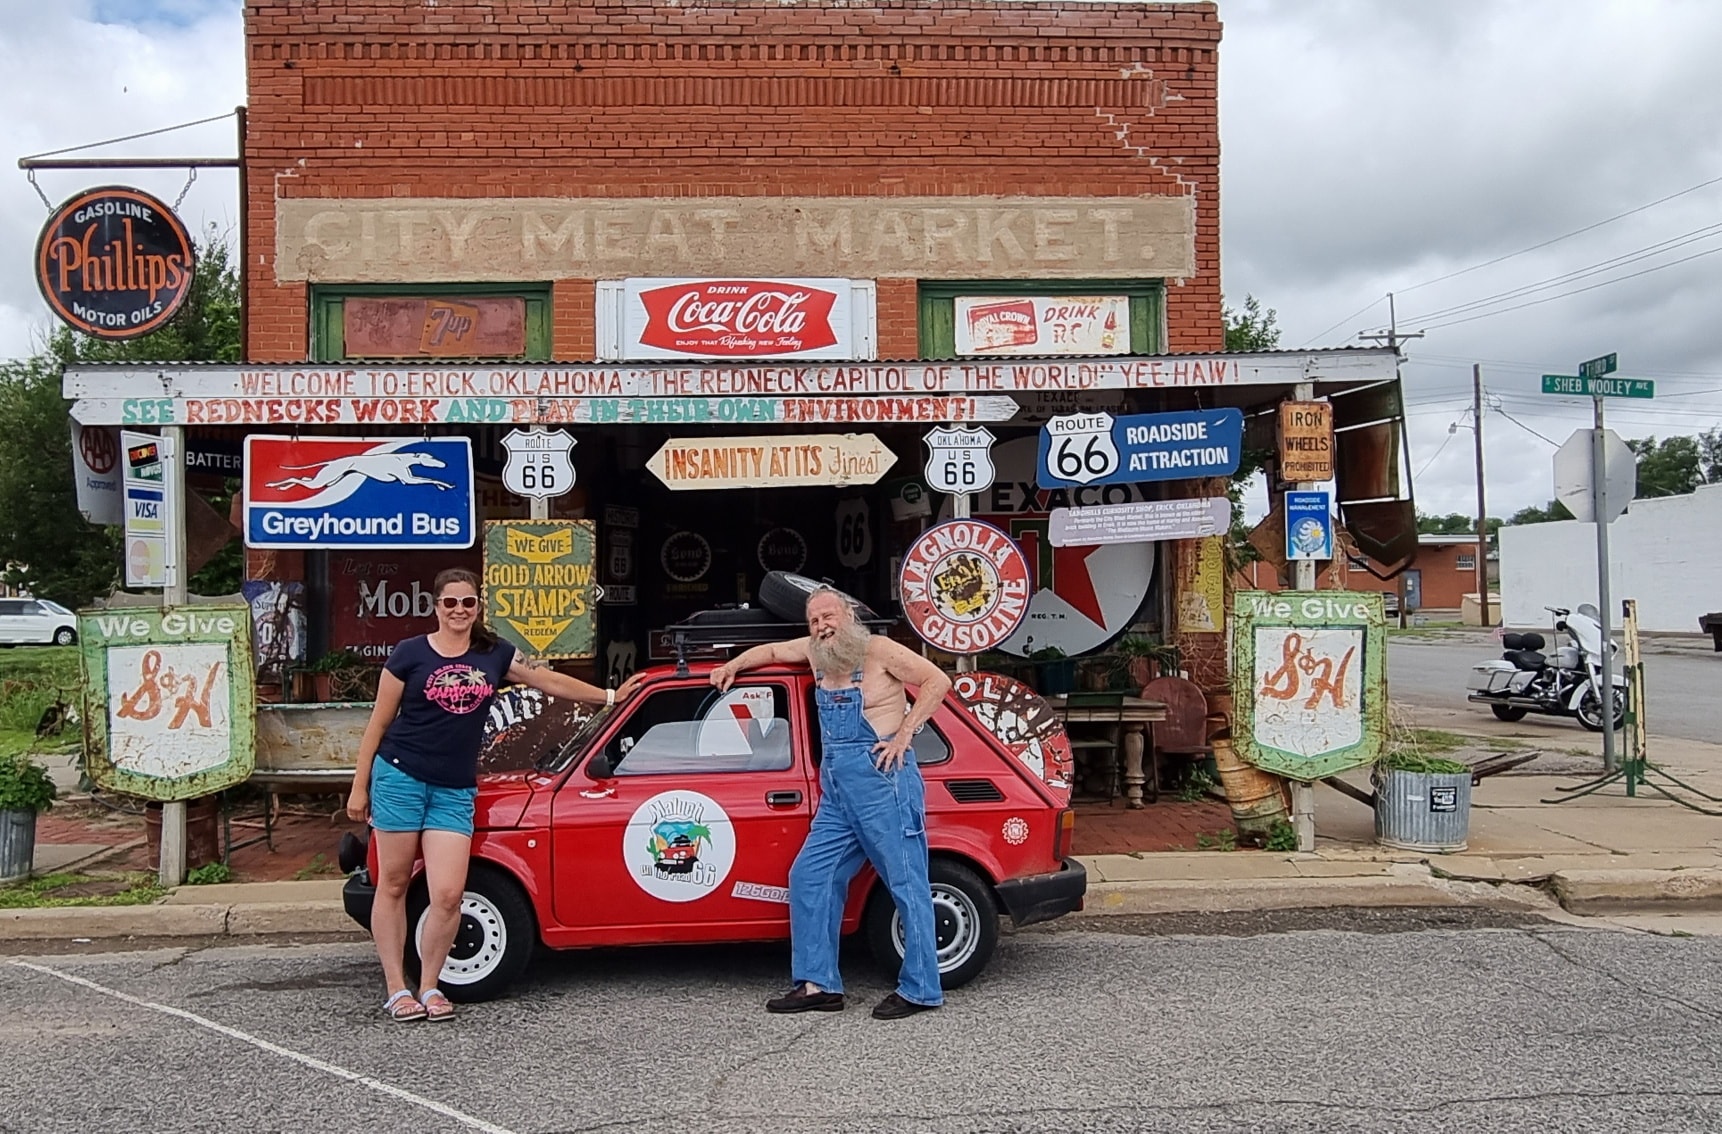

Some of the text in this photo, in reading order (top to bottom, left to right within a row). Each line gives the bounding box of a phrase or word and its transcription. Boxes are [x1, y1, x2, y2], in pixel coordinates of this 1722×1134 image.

[74, 203, 152, 224] GASOLINE
[304, 207, 1156, 262] CITY MEAT MARKET.
[50, 218, 183, 304] Phillips
[707, 286, 749, 294] DRINK
[73, 301, 162, 326] MOTOR OILS
[667, 291, 811, 333] Coca-Cola
[1000, 311, 1031, 325] CROWN
[1043, 305, 1100, 323] DRINK
[718, 336, 756, 349] Refreshing
[775, 336, 802, 349] Feeling
[240, 371, 357, 396] WELCOME
[367, 371, 398, 396] TO
[489, 370, 623, 395] OKLAHOMA
[700, 367, 809, 393] REDNECK
[818, 365, 912, 393] CAPITOL
[923, 364, 950, 392] OF
[960, 363, 1003, 390] THE
[1120, 361, 1165, 387] YEE
[1554, 377, 1582, 392] SHEB
[1587, 379, 1632, 395] WOOLEY
[1635, 382, 1648, 390] AVE
[122, 395, 976, 424] SEE REDNECKS WORK AND PLAY IN THEIR OWN ENVIRONMENT!
[1290, 411, 1323, 427] IRON
[1055, 417, 1105, 431] ROUTE
[1126, 421, 1208, 445] ROADSIDE
[525, 438, 552, 448] ROUTE
[937, 435, 982, 446] OKLAHOMA
[1285, 437, 1329, 451] WHEELS
[664, 444, 882, 480] INSANITY AT ITS Finest
[1057, 434, 1110, 477] 66
[1128, 447, 1229, 472] ATTRACTION
[1285, 461, 1330, 472] PROHIBITED
[523, 466, 555, 488] 66
[945, 462, 975, 485] 66
[135, 501, 158, 518] VISA
[262, 511, 461, 541] Greyhound Bus
[841, 512, 865, 556] 66
[514, 539, 565, 553] WE GIVE
[488, 564, 593, 586] GOLD ARROW
[614, 557, 627, 574] 66
[903, 524, 1014, 604] MAGNOLIA
[495, 588, 586, 618] STAMPS
[922, 579, 1025, 650] GASOLINE
[1250, 597, 1370, 620] We Give
[97, 614, 235, 637] We Give
[1259, 632, 1356, 710] S&H
[116, 650, 221, 730] S&H
[742, 692, 761, 700] Ask
[691, 861, 716, 887] 66
